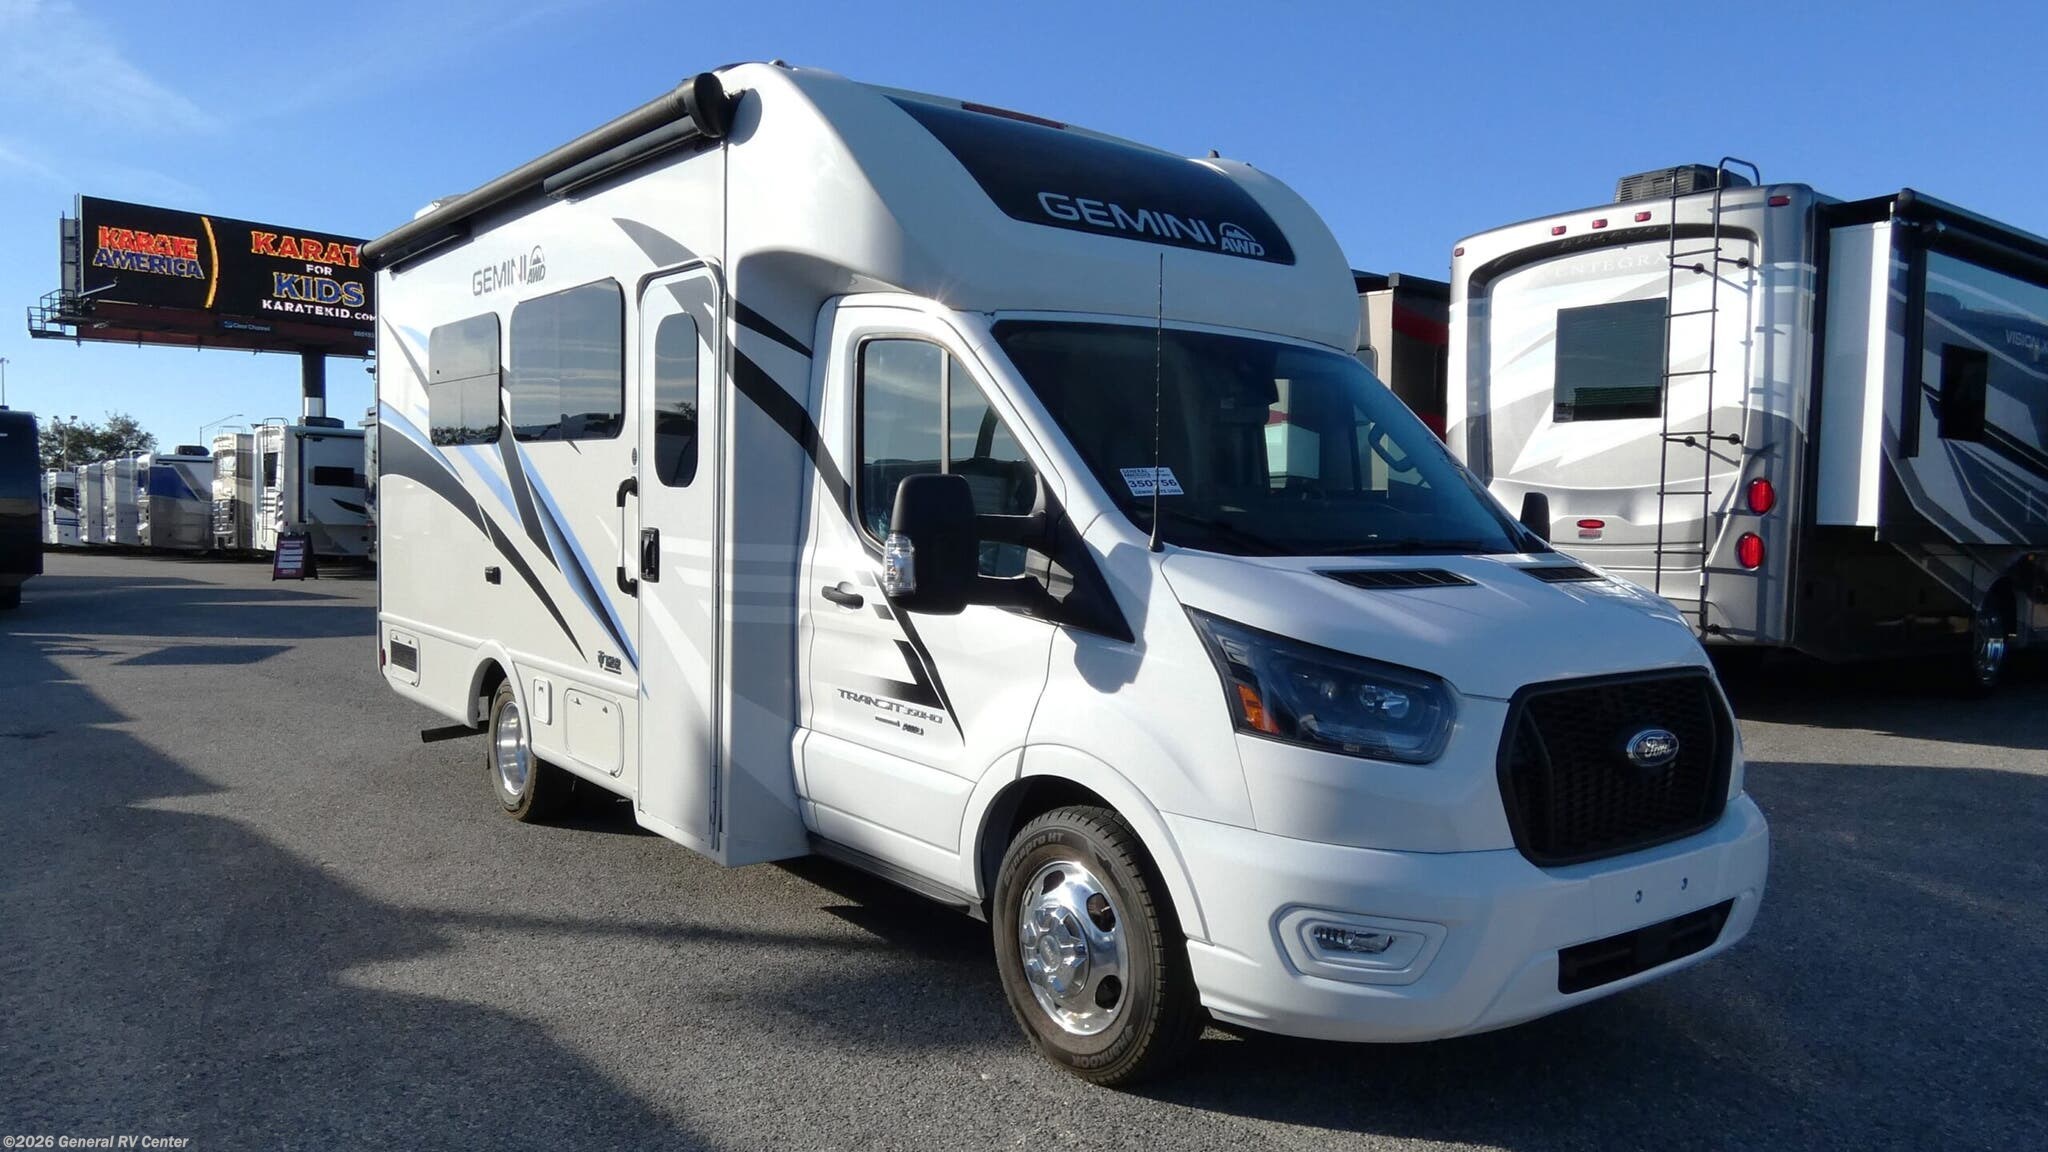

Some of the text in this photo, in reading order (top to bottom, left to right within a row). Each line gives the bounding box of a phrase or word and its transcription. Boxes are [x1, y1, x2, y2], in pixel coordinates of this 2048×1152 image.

[1037, 191, 1265, 257] GEMINI AWD
[98, 225, 198, 261] KARATE
[250, 231, 360, 268] KARAT
[93, 247, 205, 280] AMERICA
[305, 263, 333, 276] FOR
[472, 254, 546, 296] GEMINI AWD
[272, 272, 365, 307] KIDS
